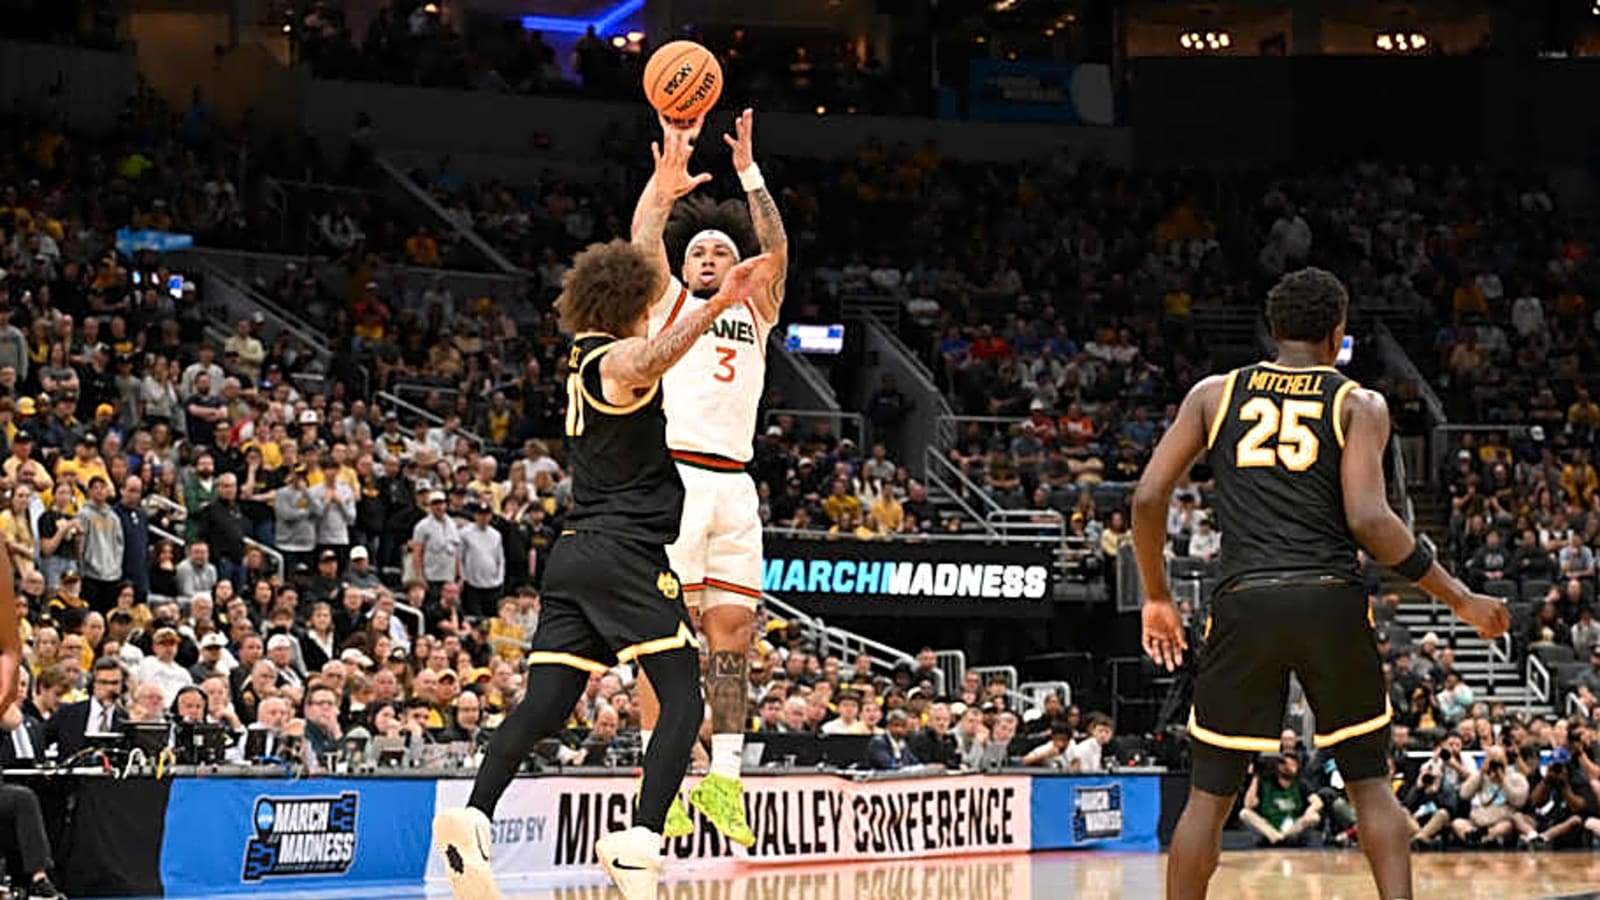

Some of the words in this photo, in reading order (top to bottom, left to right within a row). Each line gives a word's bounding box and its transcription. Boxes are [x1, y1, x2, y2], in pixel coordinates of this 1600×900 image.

[663, 63, 692, 96] NCAA
[703, 319, 754, 344] ANES
[713, 346, 737, 383] 3
[1247, 370, 1323, 395] MITCHELL
[1236, 396, 1324, 472] 25
[273, 802, 330, 832] MARCH
[491, 818, 524, 844] STED
[526, 816, 547, 842] BY
[744, 790, 844, 856] VALLEY
[852, 787, 1014, 853] CONFERENCE
[278, 832, 355, 863] MADNESS
